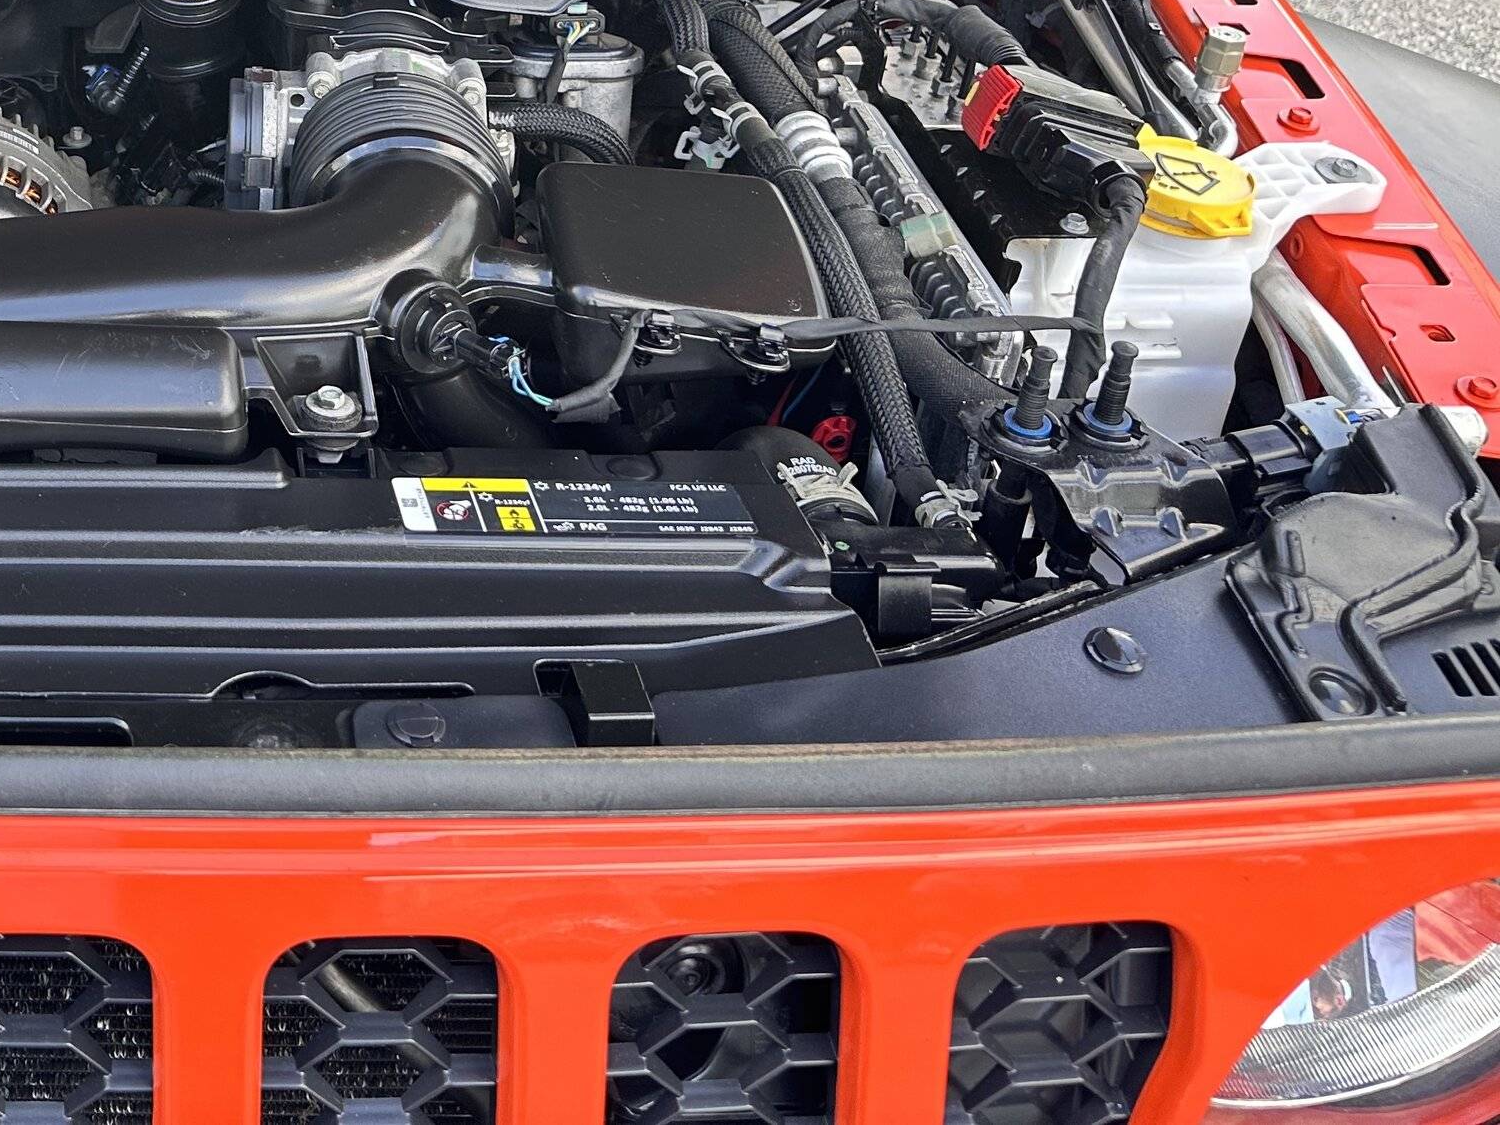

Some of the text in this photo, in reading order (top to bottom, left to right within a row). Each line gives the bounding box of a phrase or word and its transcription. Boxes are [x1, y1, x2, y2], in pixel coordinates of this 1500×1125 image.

[790, 457, 816, 466] RAD
[555, 482, 612, 493] R-1234yf
[707, 484, 727, 492] LLC
[579, 522, 608, 531] PAG
